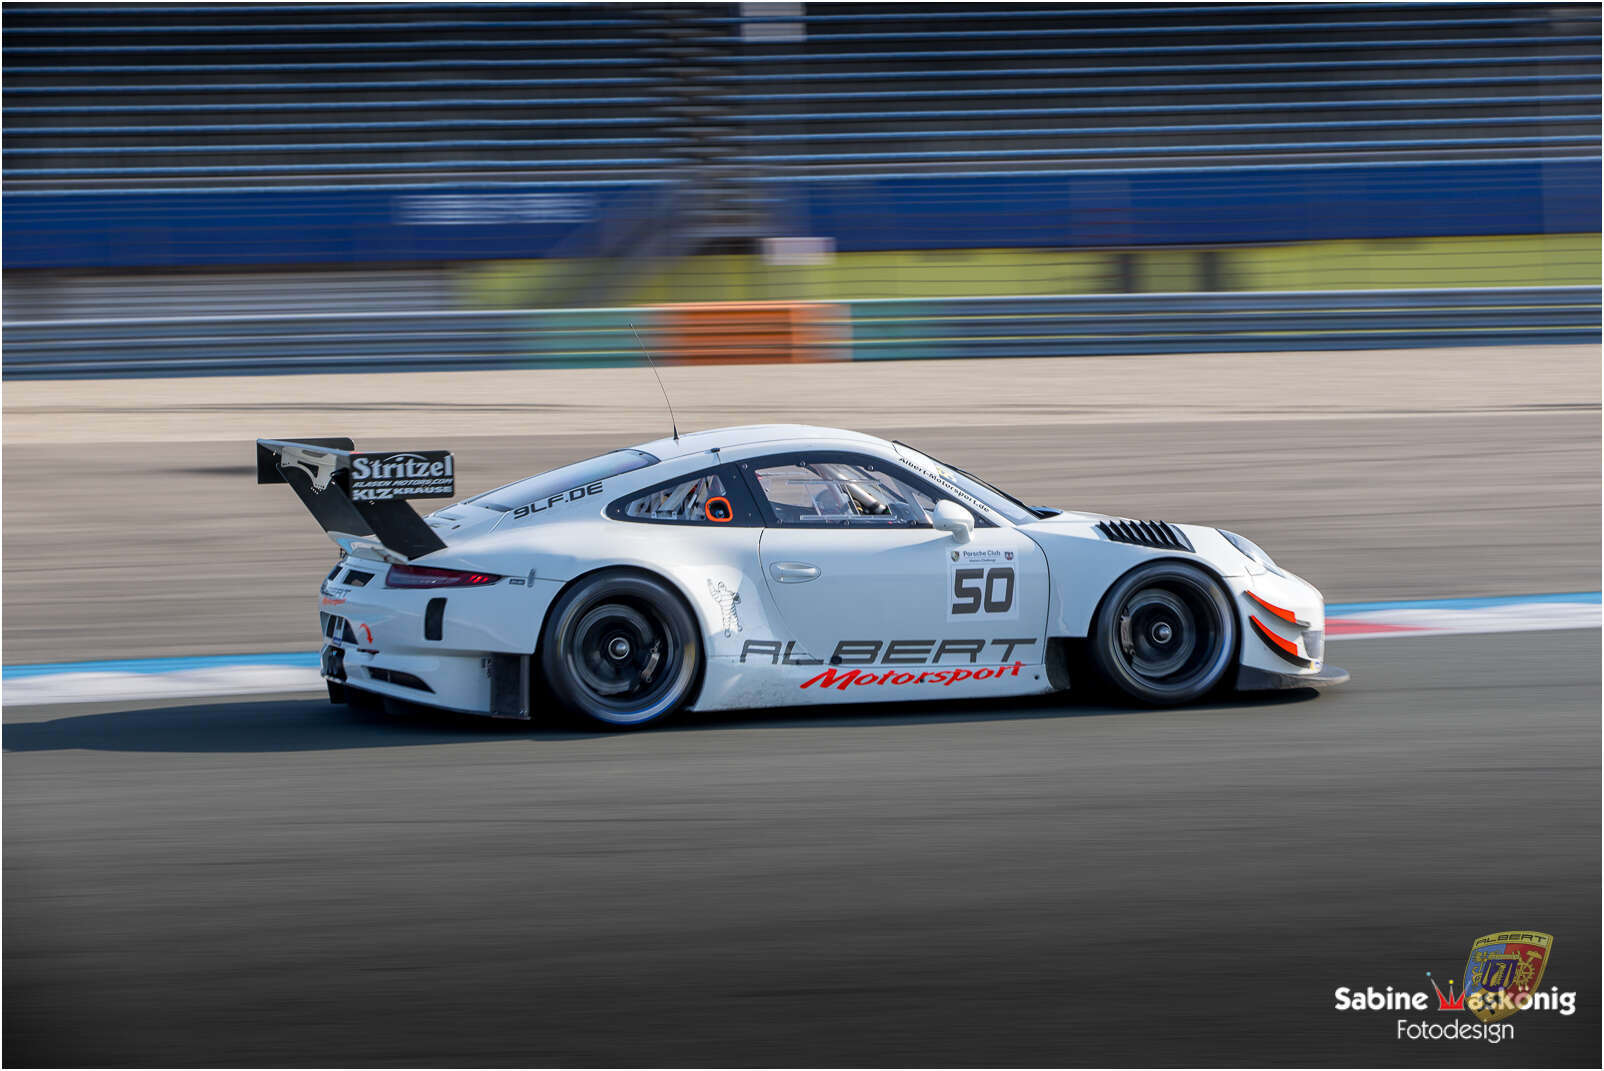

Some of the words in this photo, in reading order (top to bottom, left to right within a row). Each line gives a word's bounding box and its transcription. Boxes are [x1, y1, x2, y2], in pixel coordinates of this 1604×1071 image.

[352, 455, 453, 480] Stritzel
[352, 488, 393, 500] KLZ
[393, 485, 453, 495] KRAUSE
[513, 481, 604, 520] 9LF.DE
[951, 567, 1015, 615] 50
[739, 638, 1038, 665] ALBERT
[799, 661, 1026, 691] Motorsport
